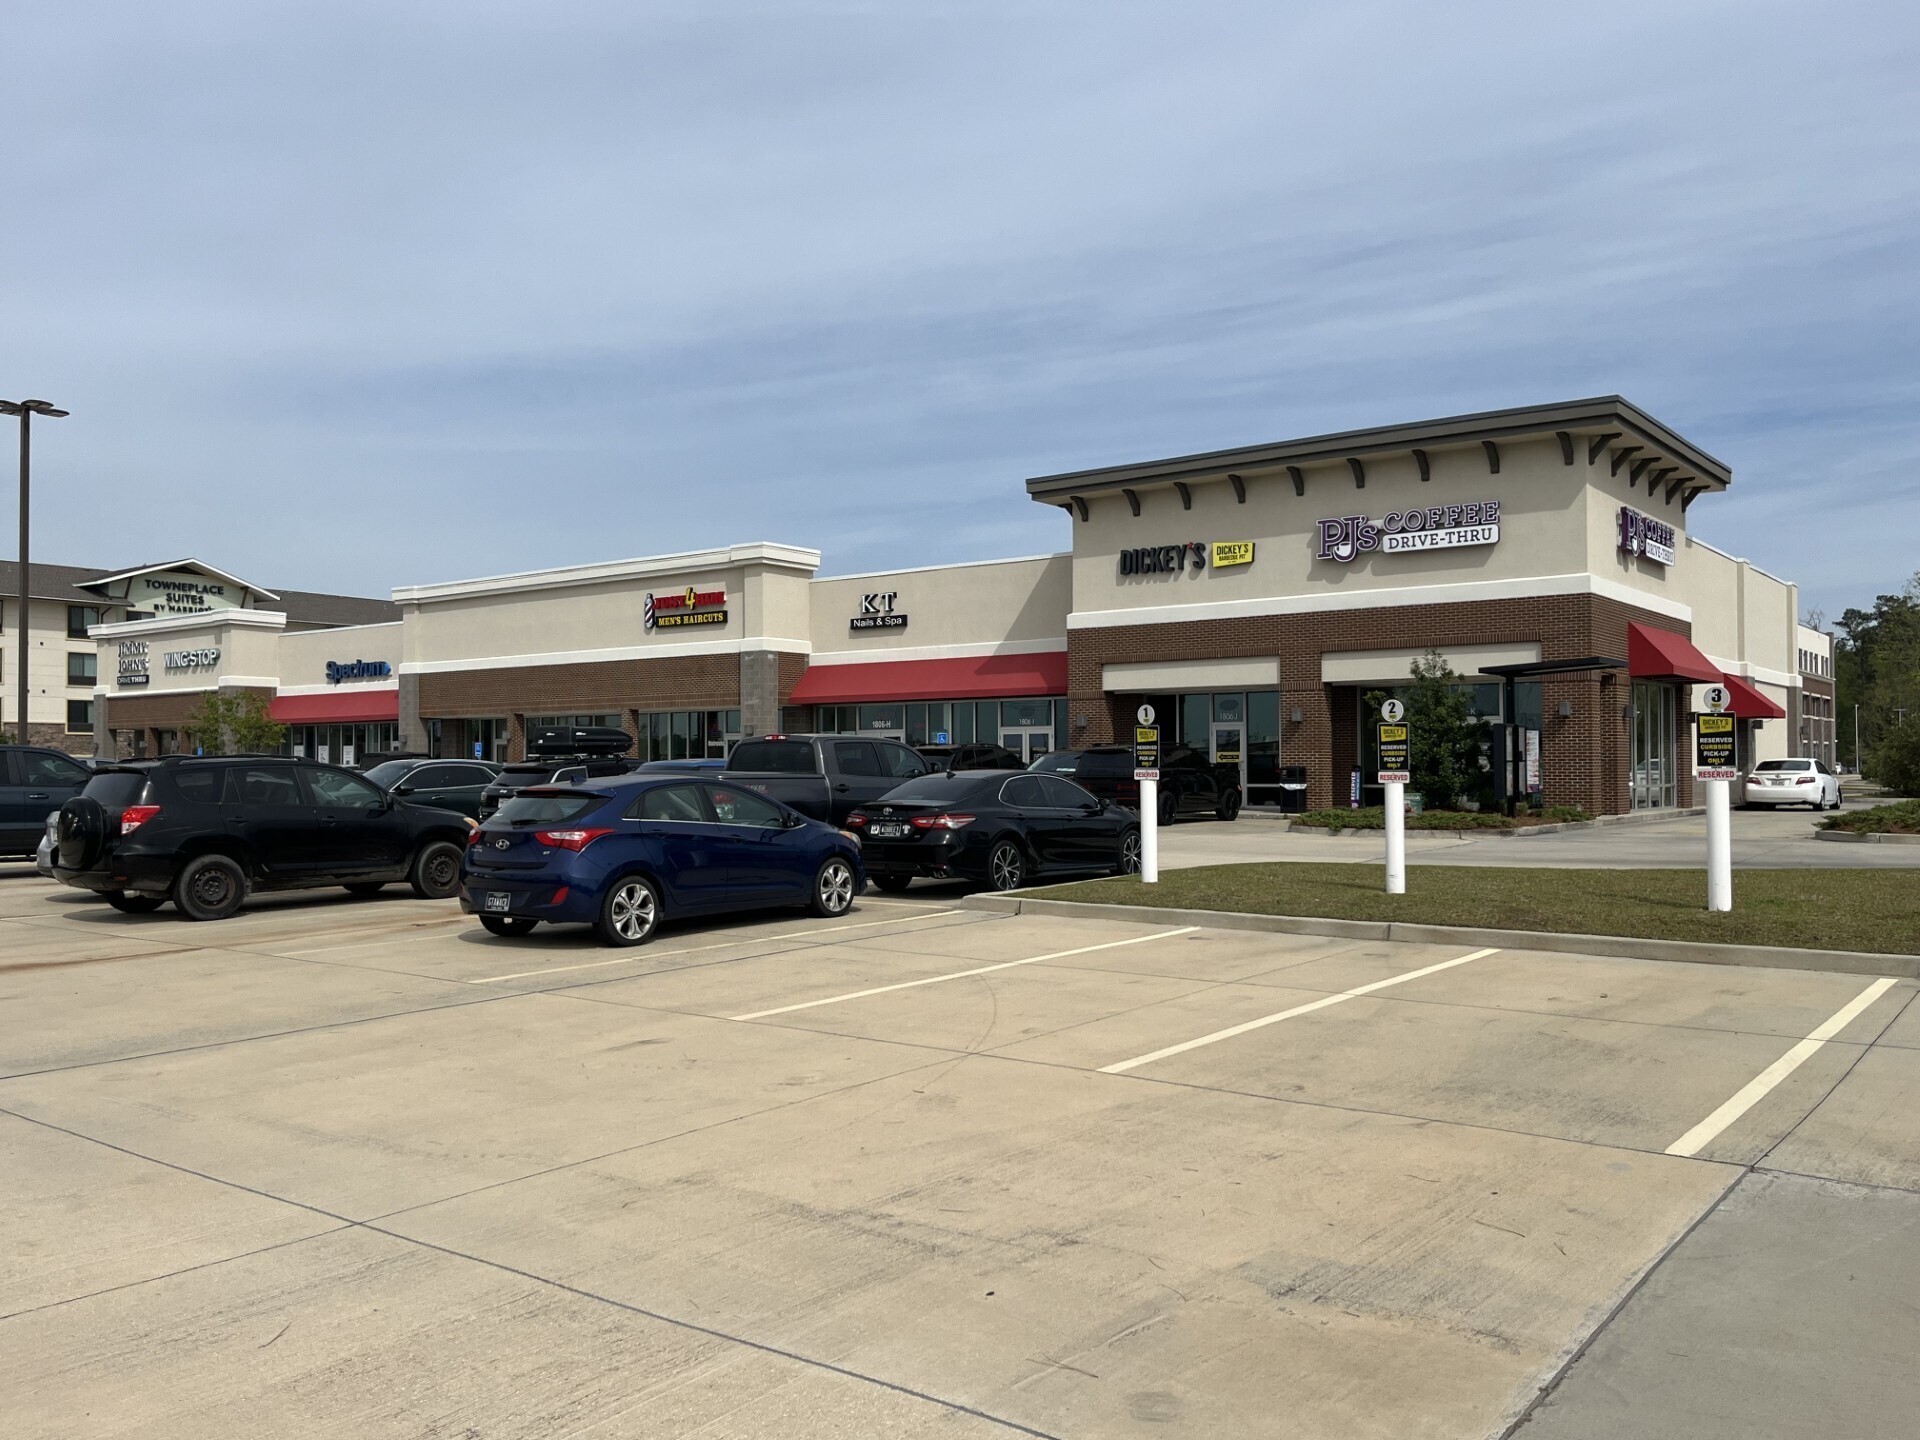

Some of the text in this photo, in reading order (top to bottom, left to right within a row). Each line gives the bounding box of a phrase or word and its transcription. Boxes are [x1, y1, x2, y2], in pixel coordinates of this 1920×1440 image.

[1383, 501, 1500, 533] COFFEE
[1388, 528, 1493, 550] DRIVE-THRU
[1645, 518, 1675, 549] COFFEE
[1216, 543, 1249, 555] DICKEY'S
[1119, 542, 1206, 576] DICKEY'S
[144, 579, 224, 595] TOWNEPLACE
[166, 592, 204, 605] SUITES
[685, 586, 696, 611] 4
[153, 603, 165, 612] BY
[658, 612, 724, 626] MEN'S HAIRCUTS
[853, 616, 902, 627] Nails & Spa
[118, 641, 149, 657] JIMMY
[325, 659, 386, 684] Spectrum
[1711, 688, 1722, 703] 3
[1143, 706, 1149, 718] 1
[1388, 701, 1397, 714] 2
[1702, 718, 1729, 726] DICKEY'S
[1698, 770, 1735, 779] RESERVED
